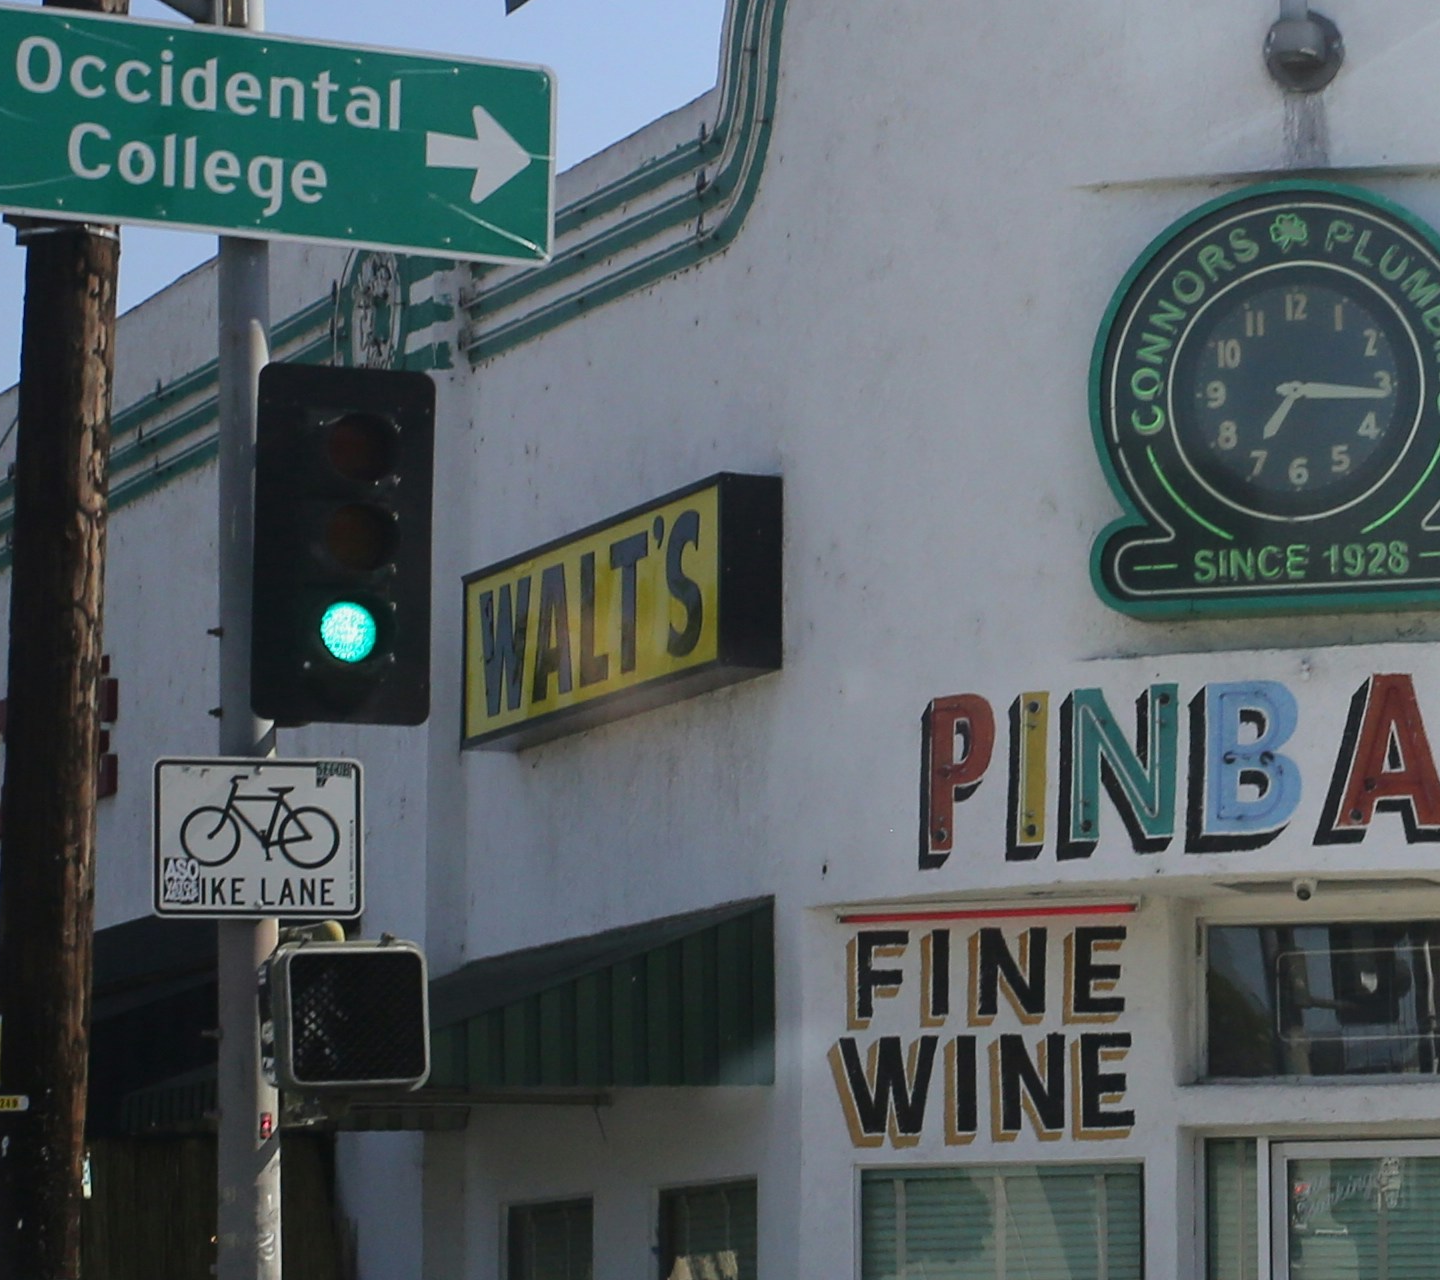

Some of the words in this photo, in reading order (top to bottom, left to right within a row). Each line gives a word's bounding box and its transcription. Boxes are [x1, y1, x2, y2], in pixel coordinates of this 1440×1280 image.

[15, 36, 402, 131] Occidental
[67, 122, 328, 218] College
[1283, 293, 1308, 321] 12
[1333, 303, 1344, 332] 1
[1130, 226, 1260, 437] CONNORS
[1245, 310, 1265, 337] 11
[1216, 339, 1242, 369] 10
[1363, 329, 1380, 357] 2
[1206, 380, 1226, 409] 9
[1373, 370, 1393, 398] 3
[1217, 420, 1238, 450] 8
[1356, 411, 1381, 440] 4
[1250, 450, 1268, 476] 7
[1288, 457, 1310, 486] 6
[1330, 445, 1351, 473] 5
[1194, 544, 1309, 583] SINCE
[1322, 540, 1410, 577] 1928
[479, 508, 704, 718] WALT'S
[200, 877, 246, 906] IKE
[261, 877, 335, 907] LANE
[845, 924, 1128, 1030] FINE
[826, 1031, 1136, 1148] WINE
